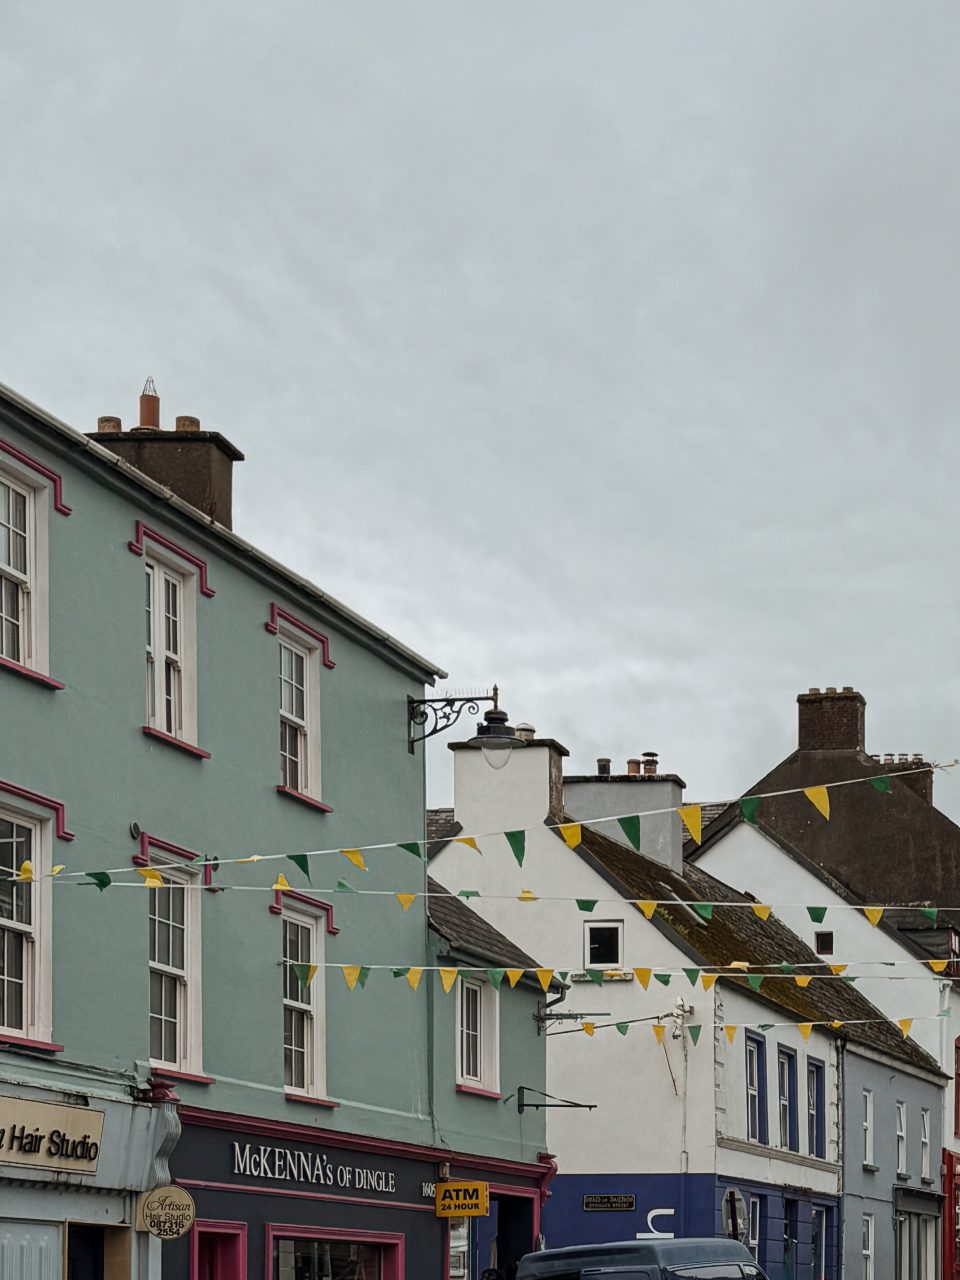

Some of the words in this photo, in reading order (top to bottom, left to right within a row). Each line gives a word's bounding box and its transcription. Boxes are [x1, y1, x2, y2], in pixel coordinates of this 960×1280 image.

[10, 1124, 45, 1154] Hair
[48, 1129, 99, 1161] Studio
[337, 1165, 353, 1187] OF
[355, 1168, 396, 1193] DINGLE
[441, 1188, 479, 1201] ATM
[146, 1195, 191, 1212] Artisan
[441, 1203, 452, 1211] 24
[145, 1212, 162, 1221] Hair
[164, 1213, 192, 1222] Studio
[150, 1221, 185, 1229] 087316
[157, 1228, 180, 1237] 2554
